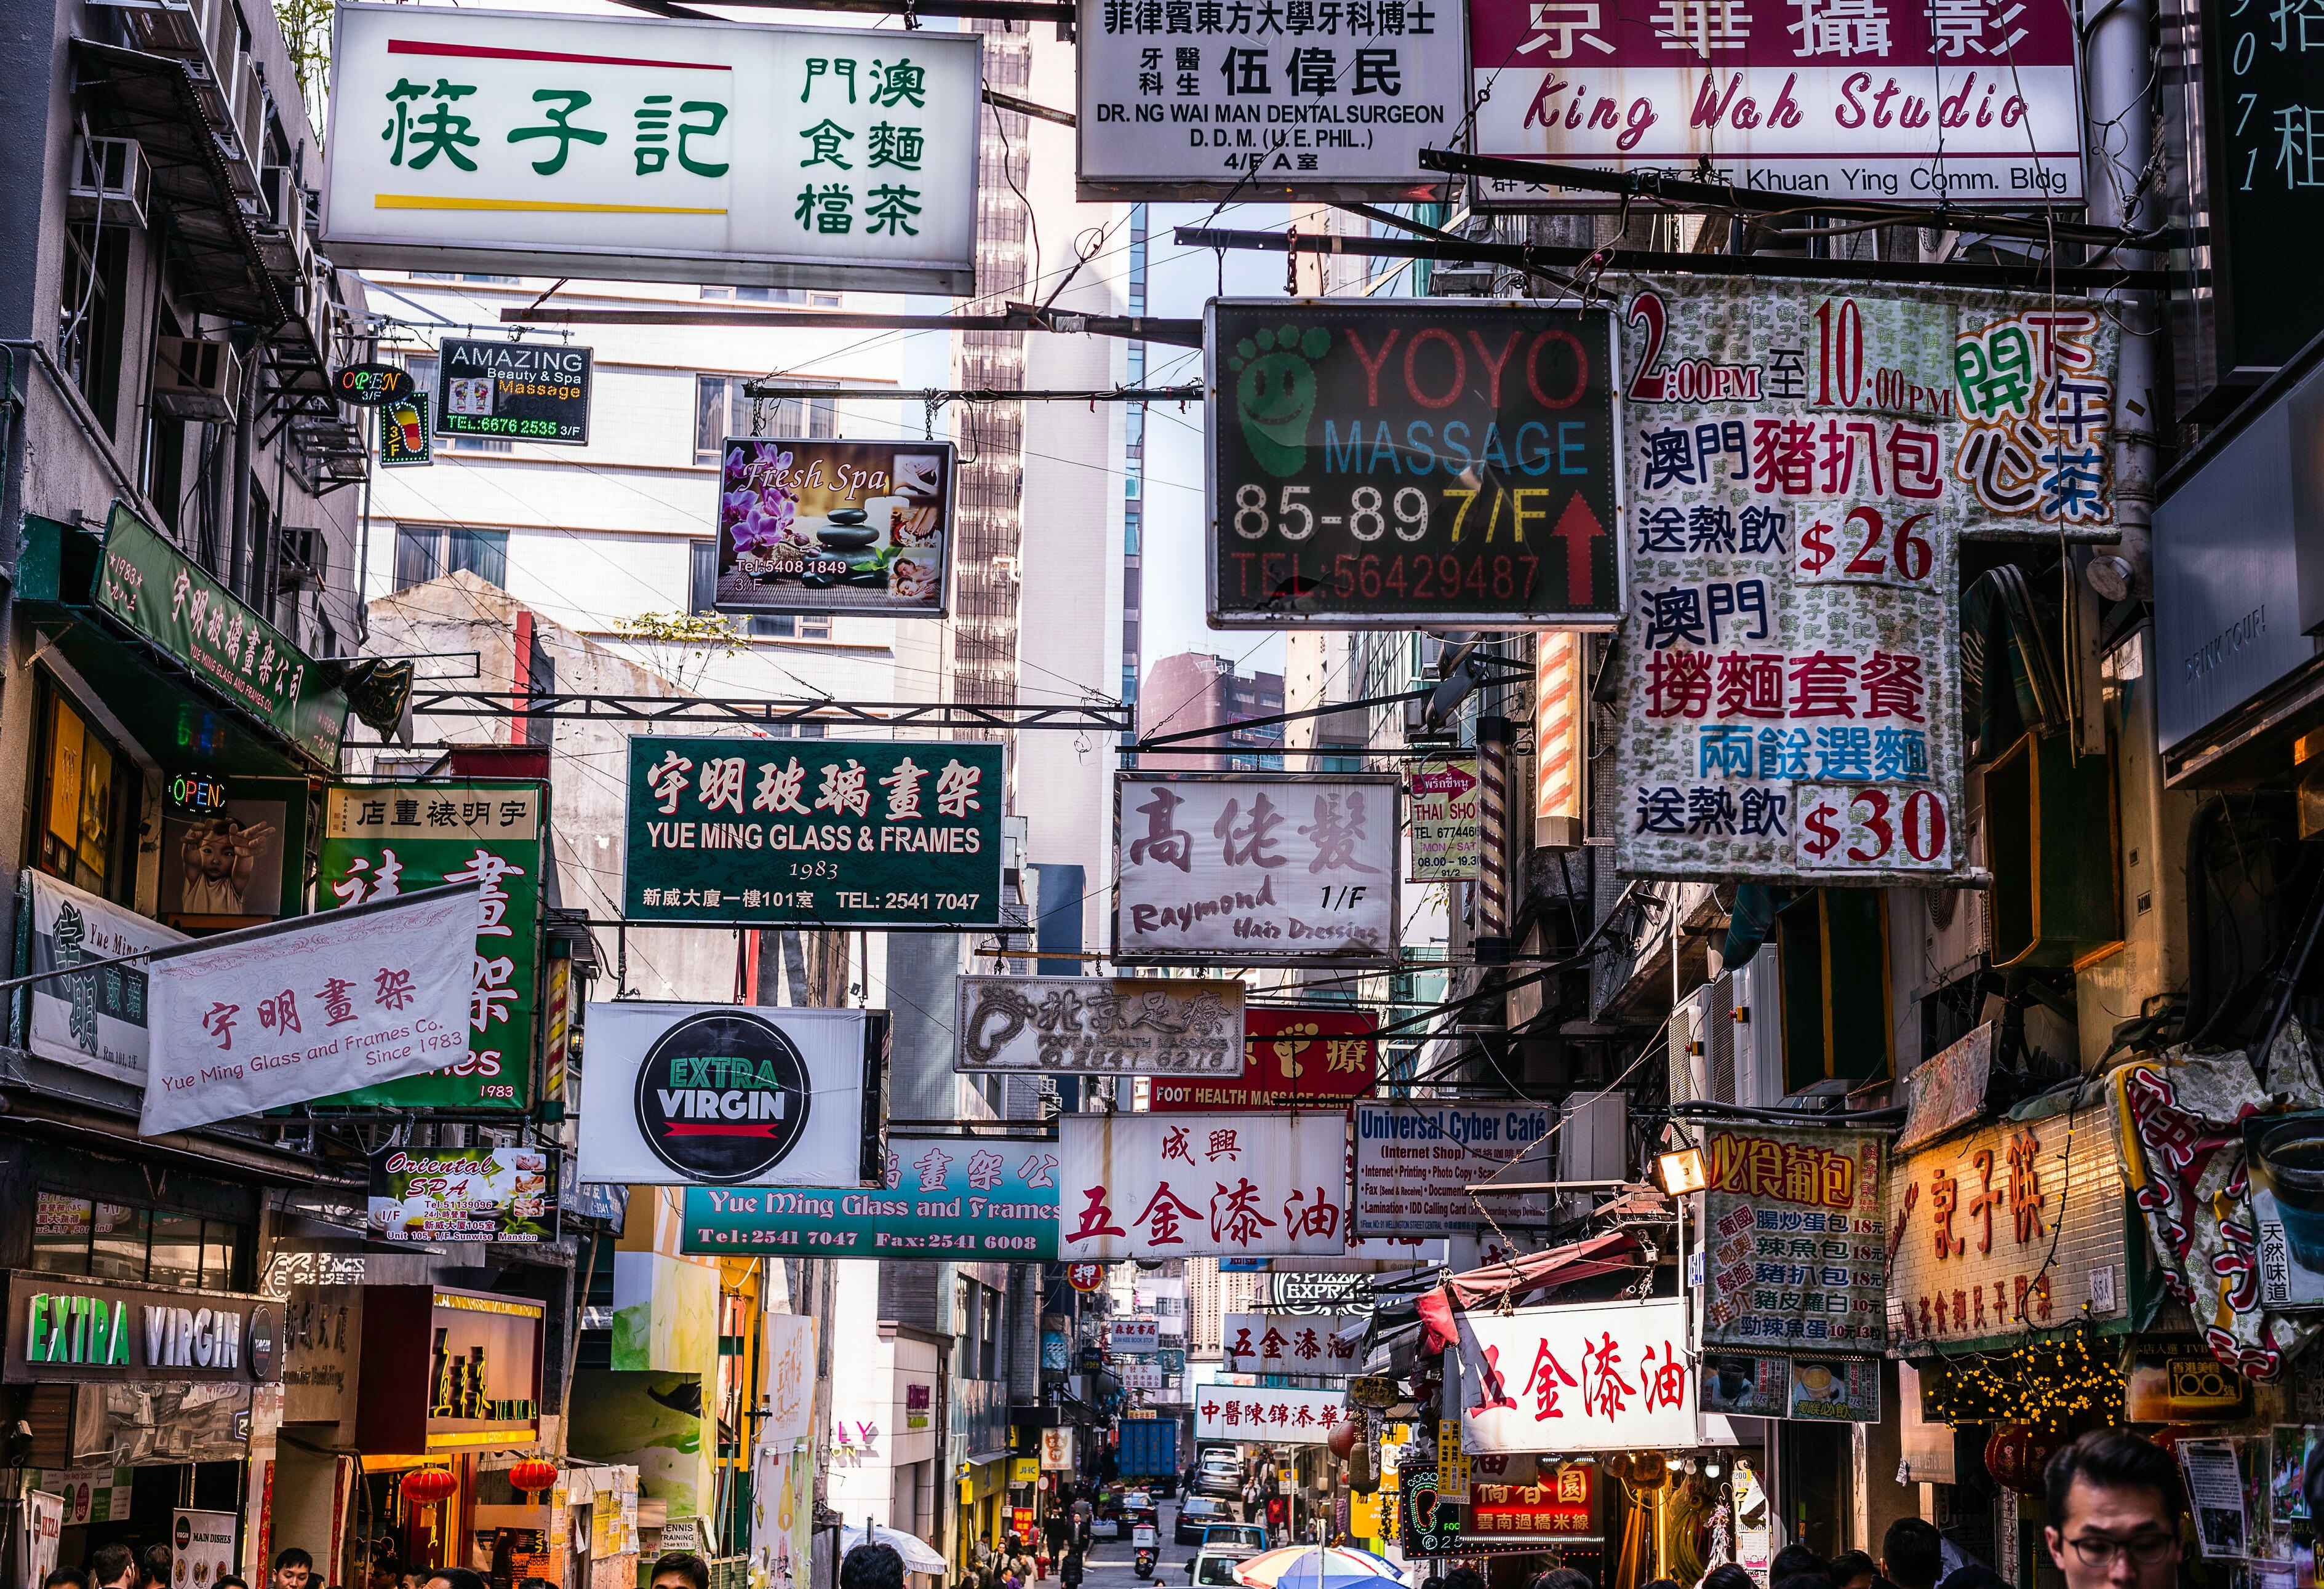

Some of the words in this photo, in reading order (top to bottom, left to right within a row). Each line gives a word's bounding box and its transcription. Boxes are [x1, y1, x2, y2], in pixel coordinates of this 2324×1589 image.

[1104, 0, 1435, 36] 菲律賓東方大學牙科博士
[1220, 46, 1402, 97] 伍偉民
[1097, 104, 1130, 123] DR.
[1136, 104, 1164, 123] NG
[1170, 104, 1208, 123] WAI
[1216, 104, 1261, 123] MAN
[1268, 104, 1344, 123] DENTAL
[1346, 104, 1444, 123] SURGEON
[1524, 71, 1659, 151] King
[1690, 71, 1803, 130] Wah
[1835, 71, 2029, 130] Studio
[382, 78, 730, 178] 筷子記
[1746, 167, 1829, 191] Khuan
[1840, 167, 1898, 197] Ying
[1909, 167, 1999, 191] Comm.
[2011, 167, 2067, 193] Bldg
[451, 345, 582, 372] AMAZING
[1626, 288, 1763, 405] 2:00PM
[1768, 348, 1806, 399] 至
[1812, 297, 1954, 417] 10:00PM
[343, 371, 401, 391] OPEN
[487, 367, 537, 383] Beauty
[554, 372, 582, 384] Spa
[1344, 328, 1589, 410] YOYO
[362, 391, 381, 401] 3/F
[499, 380, 581, 400] Massage
[521, 421, 557, 436] 2535
[561, 425, 580, 436] 3/F
[1325, 420, 1588, 476] MASSAGE
[1639, 418, 1944, 500] 澳門豬扒包
[738, 459, 824, 493] Fresh
[828, 462, 886, 501] Spa
[1234, 484, 1429, 541] 85-89
[1442, 488, 1550, 544] 7/F
[1636, 504, 1787, 556] 送熱飲
[1799, 505, 1934, 582] $26
[808, 560, 847, 574] 1849
[1231, 553, 1539, 600] TEL:56429487
[1641, 579, 1768, 650] 澳門
[171, 565, 305, 711] 宇明玻璃畫架公司
[190, 643, 201, 662] YUE
[201, 653, 216, 672] MING
[215, 663, 233, 685] GLASS
[233, 676, 246, 693] AND
[245, 683, 265, 707] FRAMES
[264, 698, 273, 714] CO.
[1644, 649, 1926, 723] 撈麵套餐
[174, 778, 220, 808] OPEN
[647, 750, 983, 821] 宇明玻璃畫架
[1413, 803, 1443, 821] THAI
[1635, 784, 1787, 838] 送熱飲
[647, 821, 695, 849] YUE
[701, 822, 764, 851] MING
[770, 824, 853, 852] GLASS
[880, 826, 981, 854] FRAMES
[1414, 827, 1432, 840] TEL
[1803, 789, 1946, 862] $30
[1422, 842, 1447, 853] MON
[1456, 842, 1477, 851] SAT
[789, 860, 839, 880] 1983
[1417, 857, 1447, 868] 08.00
[1441, 869, 1461, 877] 91/2
[836, 891, 880, 910] TEL:
[885, 892, 932, 910] 2541
[935, 893, 980, 911] 7047
[1130, 874, 1277, 935] Raymond
[1321, 885, 1367, 912] 1/F
[89, 922, 108, 950] Yue
[1232, 917, 1282, 941] Hair
[1287, 917, 1381, 946] Dressing
[202, 967, 416, 1051] 宇明畫架
[103, 1045, 114, 1061] Rm
[161, 1075, 196, 1093] Yue
[200, 1064, 244, 1086] Ming
[250, 1051, 301, 1072] Glass
[307, 1042, 338, 1060] and
[344, 1027, 410, 1051] Frames
[415, 1018, 444, 1034] Co.
[365, 1046, 412, 1067] Since
[419, 1030, 463, 1054] 1983
[669, 1056, 780, 1090] EXTRA
[479, 1083, 514, 1099] 1983
[657, 1089, 786, 1120] VIRGIN
[1157, 1086, 1192, 1102] FOOT
[1195, 1088, 1247, 1105] HEALTH
[1250, 1089, 1314, 1108] MASSAGE
[1360, 1110, 1444, 1140] Universal
[1448, 1110, 1500, 1144] Cyber
[1506, 1110, 1546, 1142] Café
[1162, 1125, 1242, 1168] 成興
[1381, 1145, 1430, 1160] (Internet
[1432, 1145, 1466, 1161] Shop)
[386, 1152, 493, 1176] Oriental
[1365, 1164, 1394, 1177] Internet
[1399, 1165, 1427, 1181] Printing
[1432, 1165, 1453, 1179] Photo
[1455, 1166, 1473, 1181] Copy
[1478, 1166, 1496, 1179] Scan
[1860, 1144, 1879, 1197] 筷子記
[405, 1177, 469, 1198] SPA
[1365, 1182, 1378, 1196] Fax
[424, 1210, 468, 1220] 24小時營業
[425, 1200, 493, 1211] Tel:51139096
[708, 1190, 759, 1214] Yue
[765, 1192, 836, 1219] Ming
[841, 1193, 909, 1219] Glass
[916, 1196, 961, 1218] and
[1064, 1176, 1340, 1248] 五金漆油
[1365, 1201, 1404, 1214] Lamination
[1409, 1201, 1423, 1214] IDD
[1424, 1201, 1448, 1217] Calling
[1450, 1203, 1467, 1215] Card
[1755, 1209, 1850, 1233] 腸炒蛋包
[386, 1230, 409, 1241] Unit
[412, 1231, 432, 1242] 105,
[434, 1232, 450, 1241] 1/F
[453, 1232, 493, 1241] Sunwise
[498, 1232, 538, 1242] Mansion
[807, 1231, 858, 1247] 7047
[984, 1235, 1038, 1251] 6008
[1755, 1235, 1850, 1260] 辣魚包
[1073, 1264, 1097, 1286] 押
[1755, 1262, 1850, 1286] 豬扒包
[2261, 1222, 2290, 1302] 天然味道
[1754, 1289, 1848, 1313] 豬皮蘿白
[2092, 1278, 2109, 1302] 85A
[1708, 1289, 1751, 1329] 推介
[26, 1293, 130, 1366] EXTRA
[143, 1305, 241, 1369] VIRGIN
[1740, 1315, 1827, 1340] 勁辣魚蛋
[1471, 1331, 1685, 1424] 五金漆油
[2173, 1361, 2221, 1374] 香港美食
[661, 1523, 694, 1533] TENNIS
[1477, 1513, 1589, 1531] 雲南過橋米線
[193, 1532, 210, 1542] MAIN
[210, 1534, 232, 1544] DISHES
